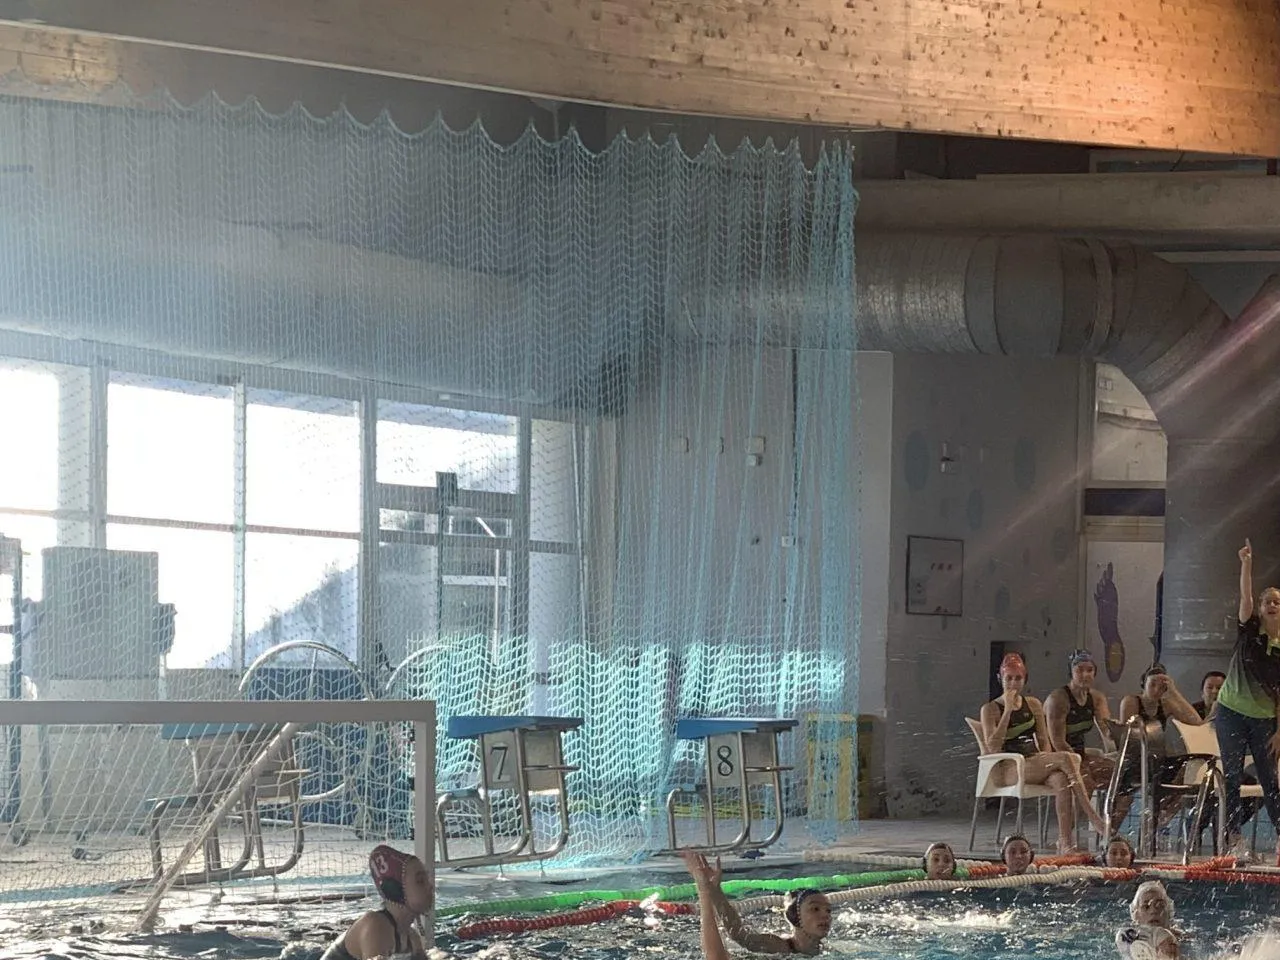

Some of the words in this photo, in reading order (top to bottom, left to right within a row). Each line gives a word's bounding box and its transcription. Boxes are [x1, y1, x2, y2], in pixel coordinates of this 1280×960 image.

[490, 745, 510, 782] 7
[717, 744, 735, 777] 8
[371, 855, 389, 878] 13
